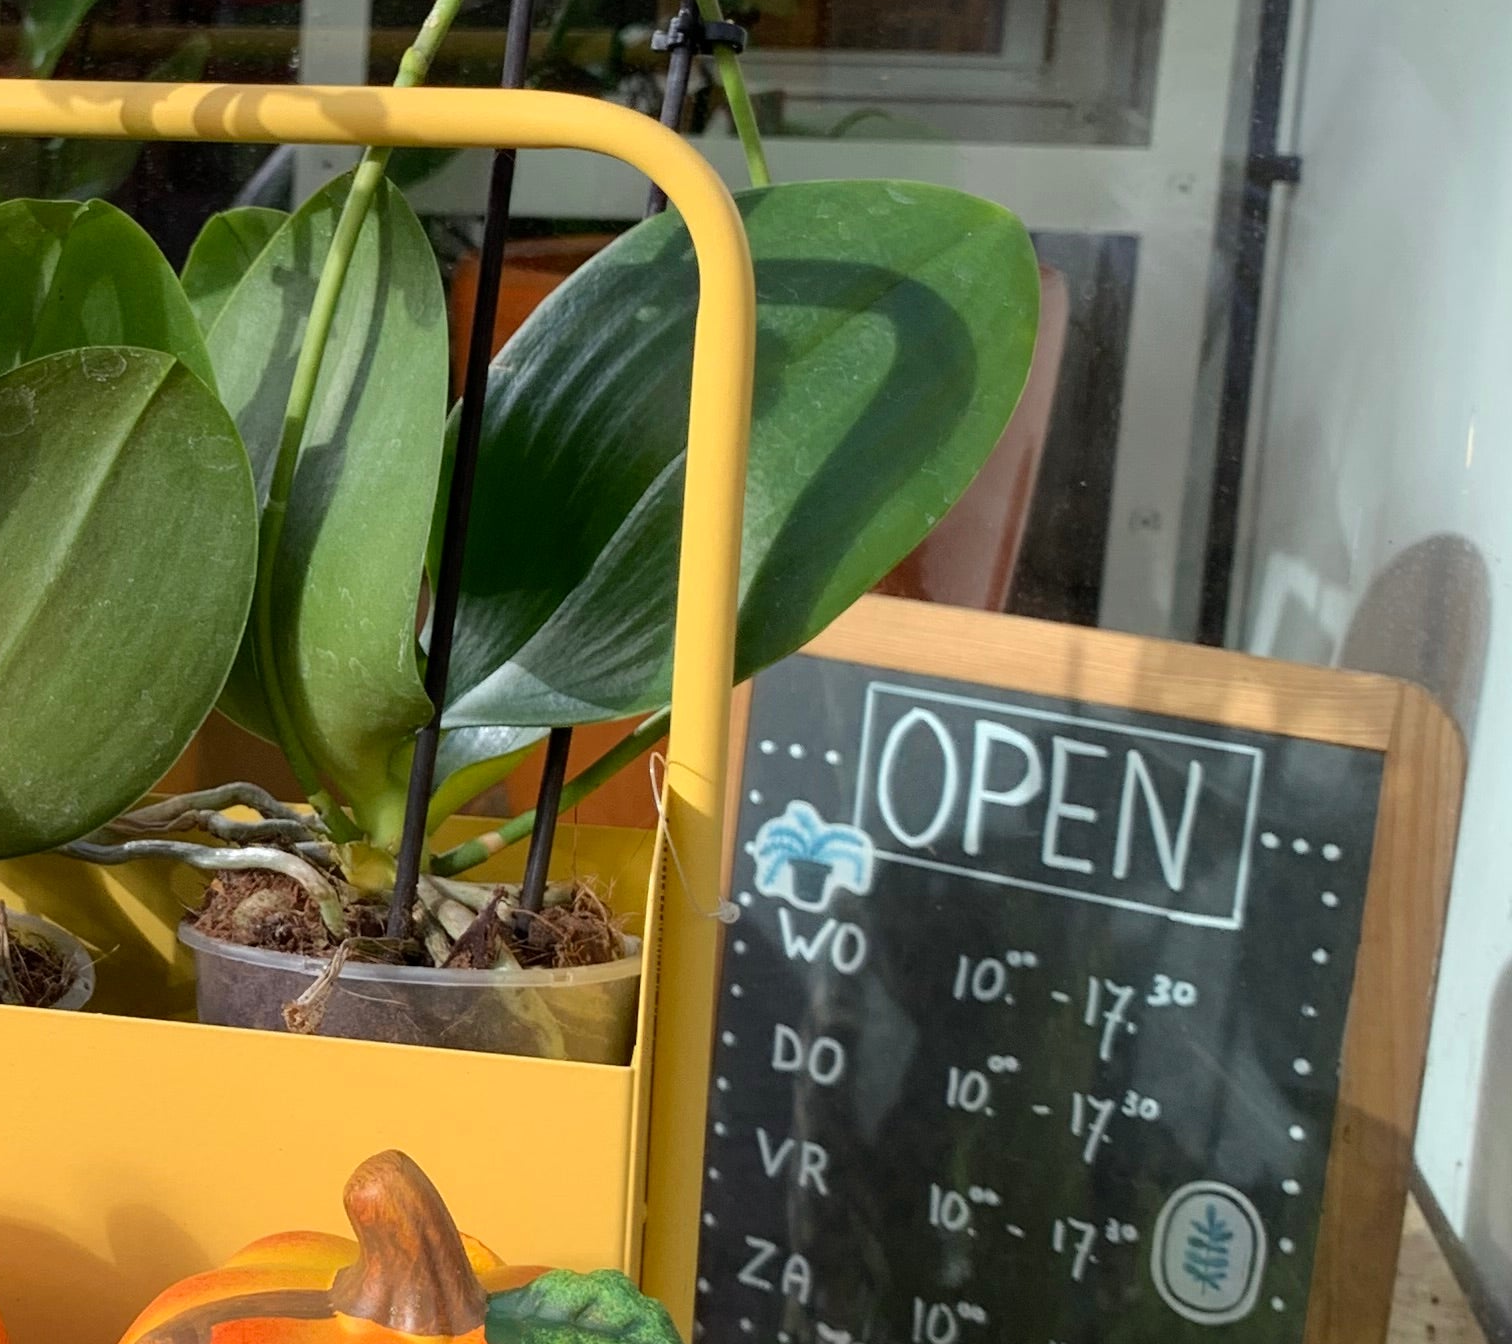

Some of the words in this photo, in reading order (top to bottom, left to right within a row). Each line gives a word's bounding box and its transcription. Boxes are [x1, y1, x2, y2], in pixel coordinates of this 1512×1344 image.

[877, 707, 1201, 892] OPEN
[779, 908, 866, 974] WO
[771, 1023, 845, 1085] DO
[755, 1127, 830, 1196] VR
[737, 1235, 812, 1304] ZA
